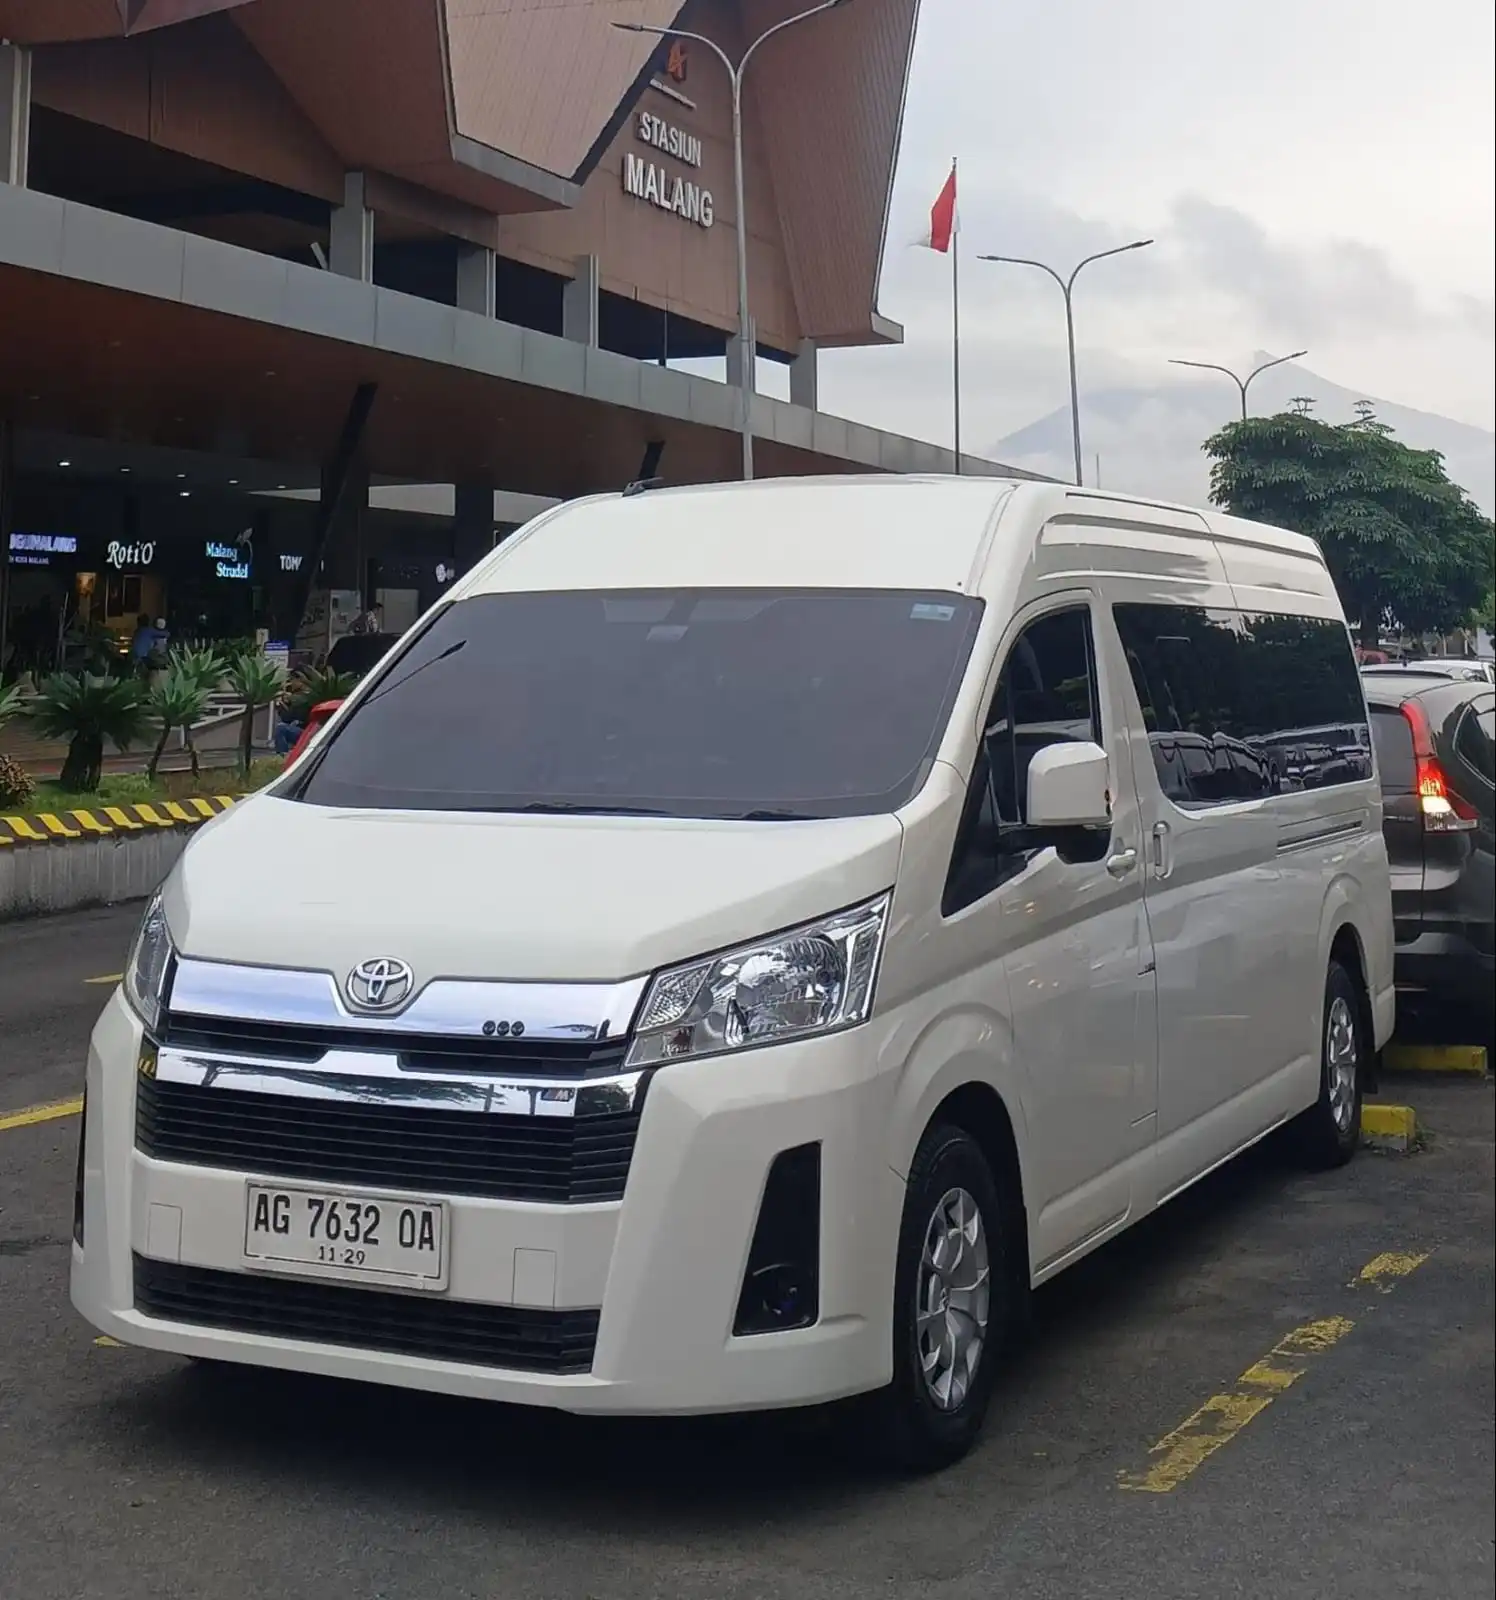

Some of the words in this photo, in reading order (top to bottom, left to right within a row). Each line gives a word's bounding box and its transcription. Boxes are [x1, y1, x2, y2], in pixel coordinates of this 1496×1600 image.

[640, 112, 702, 168] STASIUN
[626, 153, 713, 227] MALANG
[206, 541, 238, 562] Malang
[216, 562, 249, 578] Strudel
[254, 1193, 291, 1234] AG
[307, 1198, 380, 1246] 7632
[399, 1208, 435, 1251] OA
